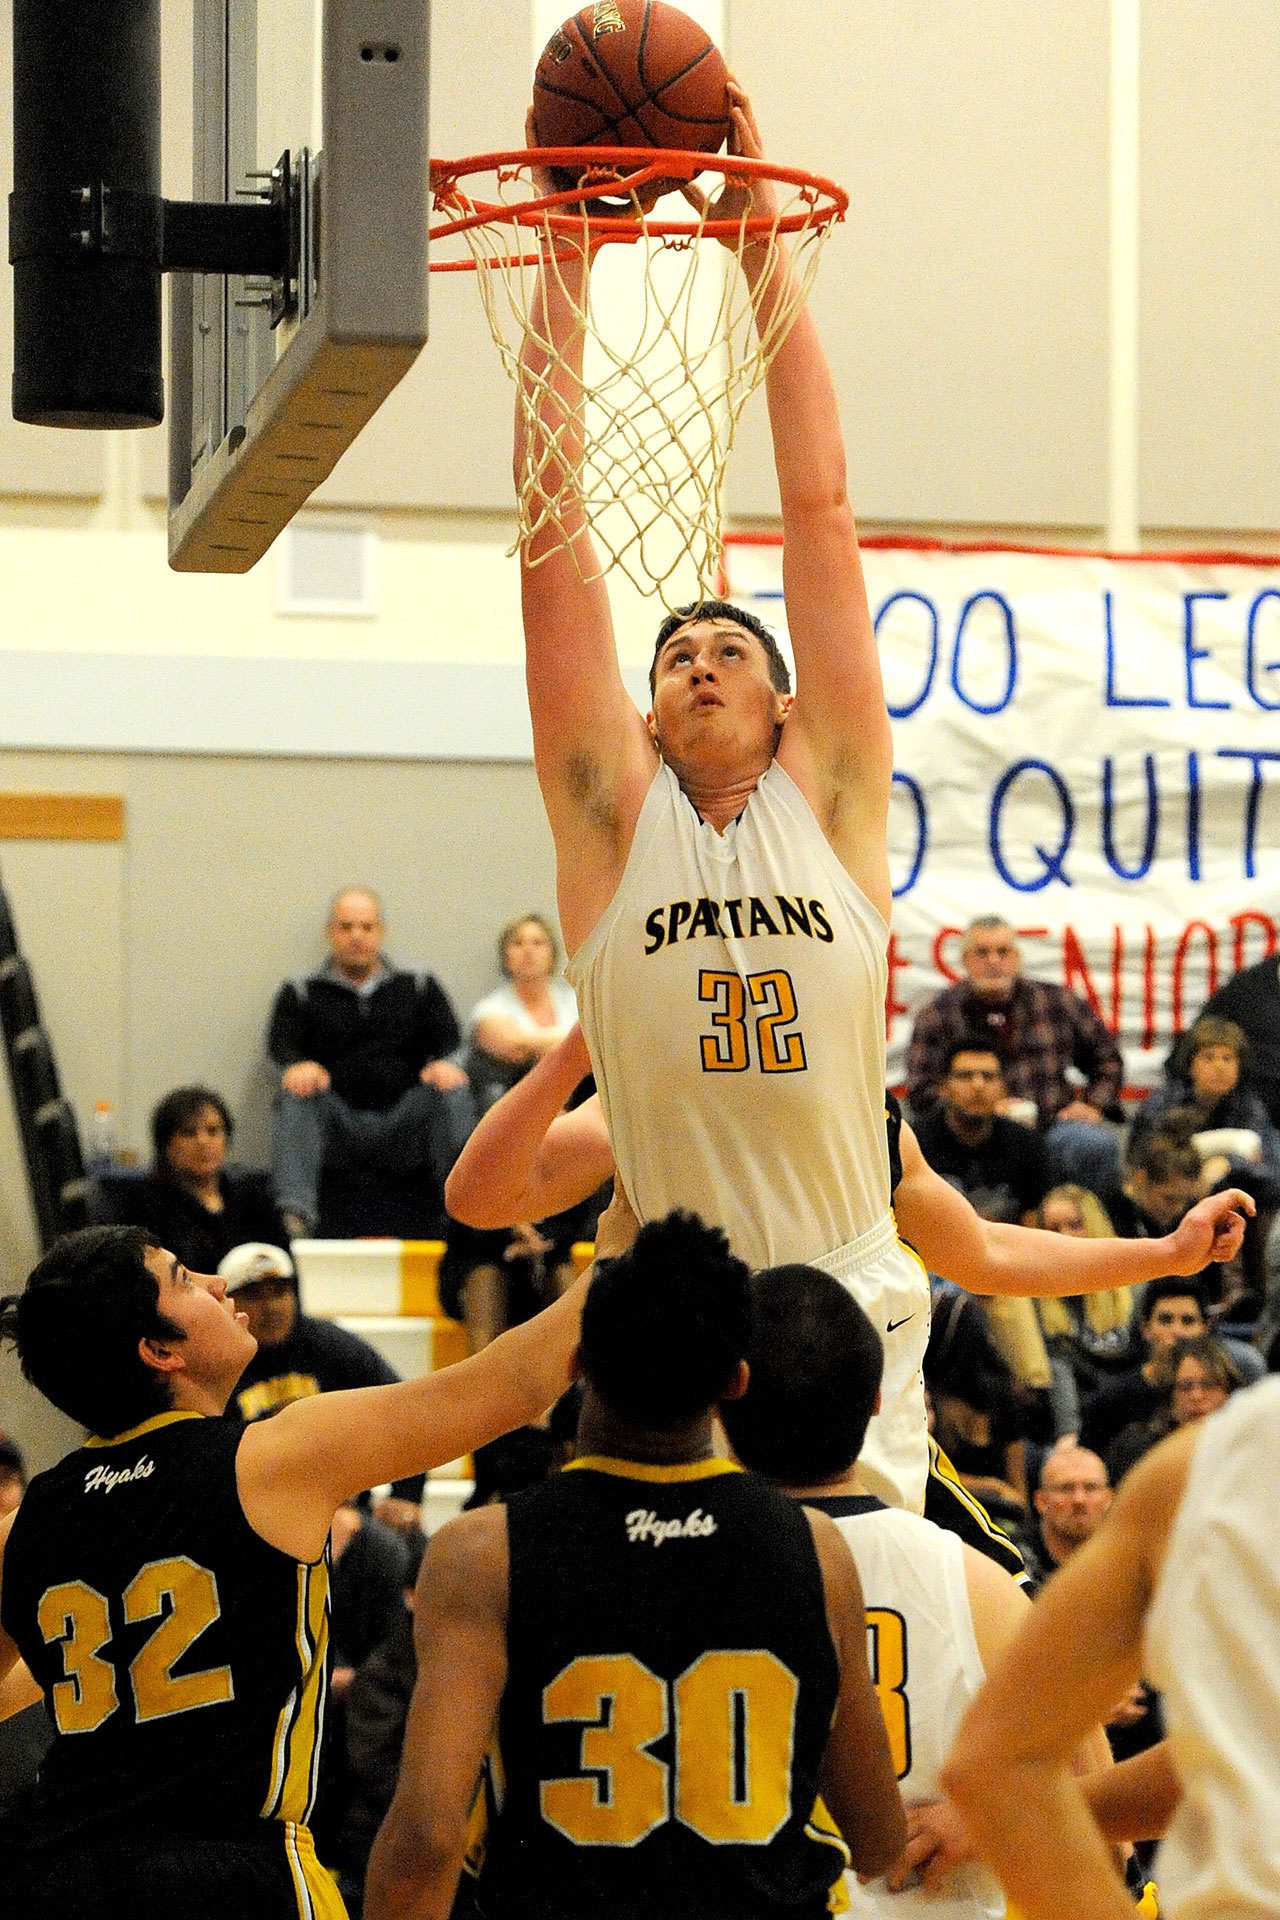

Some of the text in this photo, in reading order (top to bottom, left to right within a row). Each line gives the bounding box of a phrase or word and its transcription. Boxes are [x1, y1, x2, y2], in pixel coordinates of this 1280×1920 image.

[988, 750, 1280, 894] QUIT
[644, 894, 835, 956] SPARTANS
[697, 967, 808, 1074] 32
[84, 1454, 156, 1495] Hyaks
[625, 1508, 719, 1547] Hyaks
[37, 1554, 235, 1735] 32
[539, 1649, 799, 1848] 30
